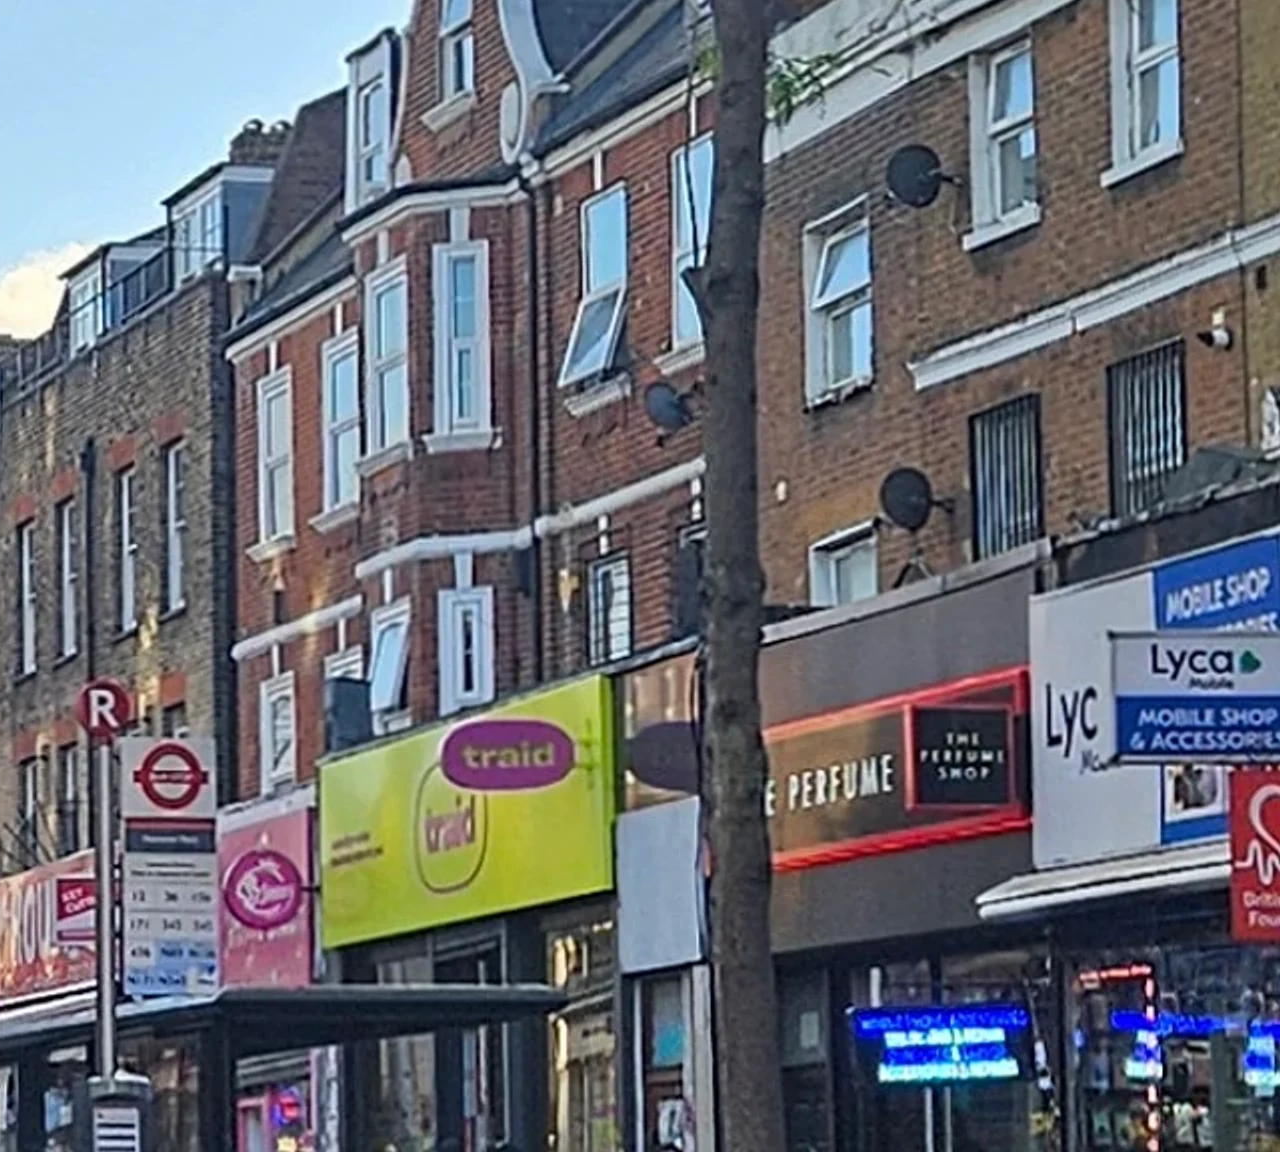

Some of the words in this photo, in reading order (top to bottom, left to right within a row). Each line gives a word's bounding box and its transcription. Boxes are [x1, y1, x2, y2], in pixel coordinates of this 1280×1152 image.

[1165, 578, 1224, 624] MOBILE
[1225, 566, 1272, 608] SHOP
[1150, 643, 1234, 681] Lyca
[1188, 677, 1234, 690] Mobile
[88, 689, 119, 728] R
[1045, 682, 1098, 759] Lyc
[1137, 708, 1215, 728] MOBILE
[1221, 708, 1278, 727] SHOP
[946, 732, 980, 746] THE
[1129, 732, 1146, 749] &
[1150, 731, 1280, 750] ACCESSORIES
[462, 741, 556, 770] traid
[920, 750, 1005, 764] PERFUME
[787, 753, 894, 812] PERFUME
[937, 766, 991, 780] SHOP
